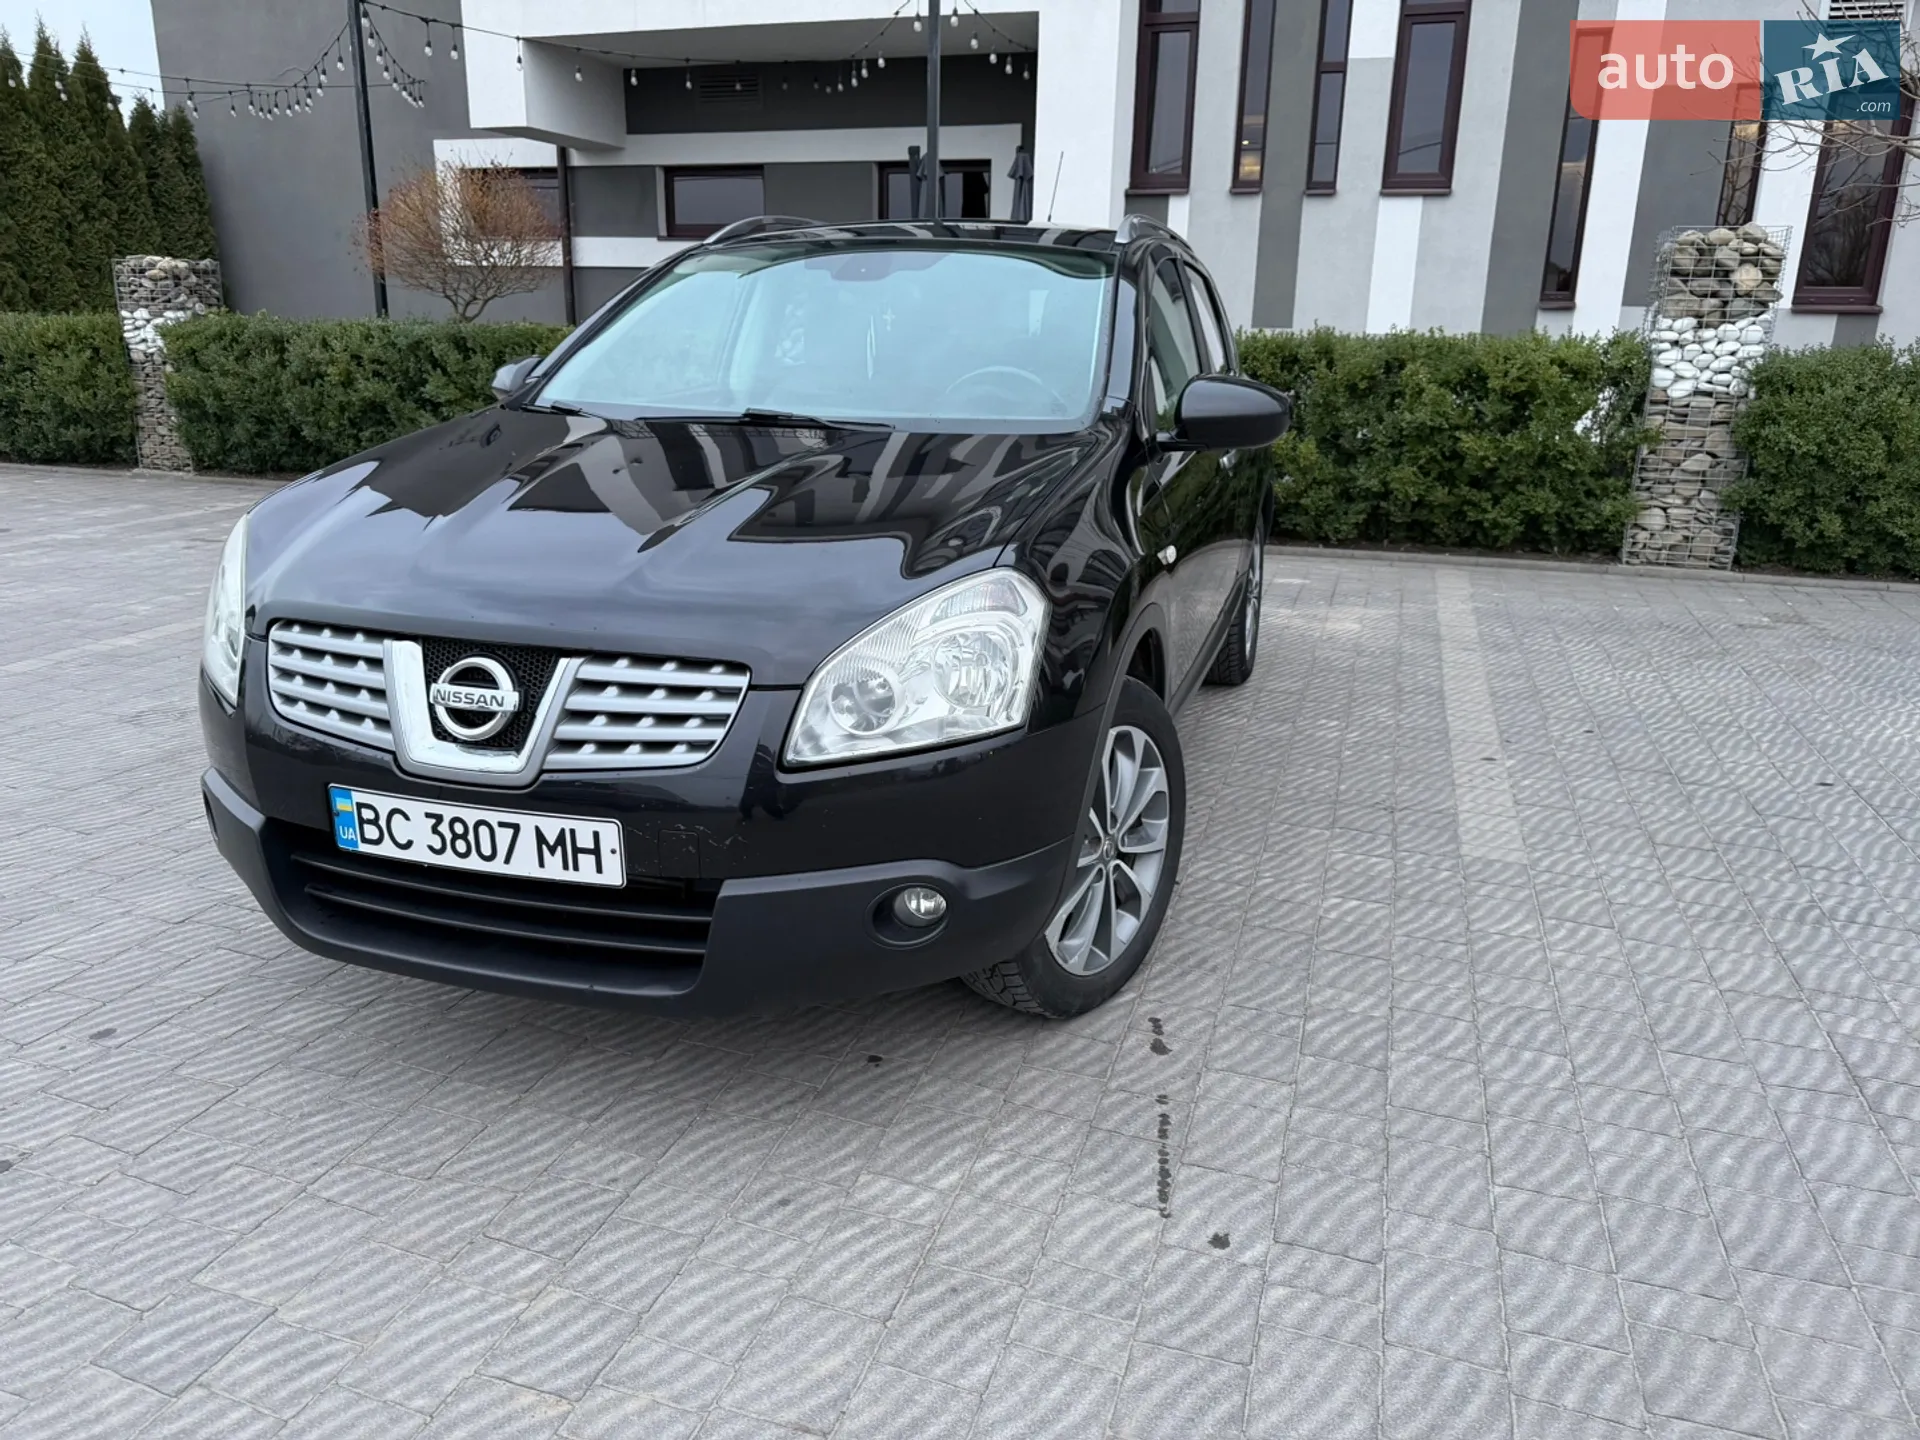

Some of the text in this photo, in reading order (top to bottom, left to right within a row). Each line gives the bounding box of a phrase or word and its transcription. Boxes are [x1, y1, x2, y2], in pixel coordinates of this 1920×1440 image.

[434, 688, 505, 707] NISSAN
[340, 825, 358, 842] UA
[355, 800, 604, 874] BC 3807 MH
